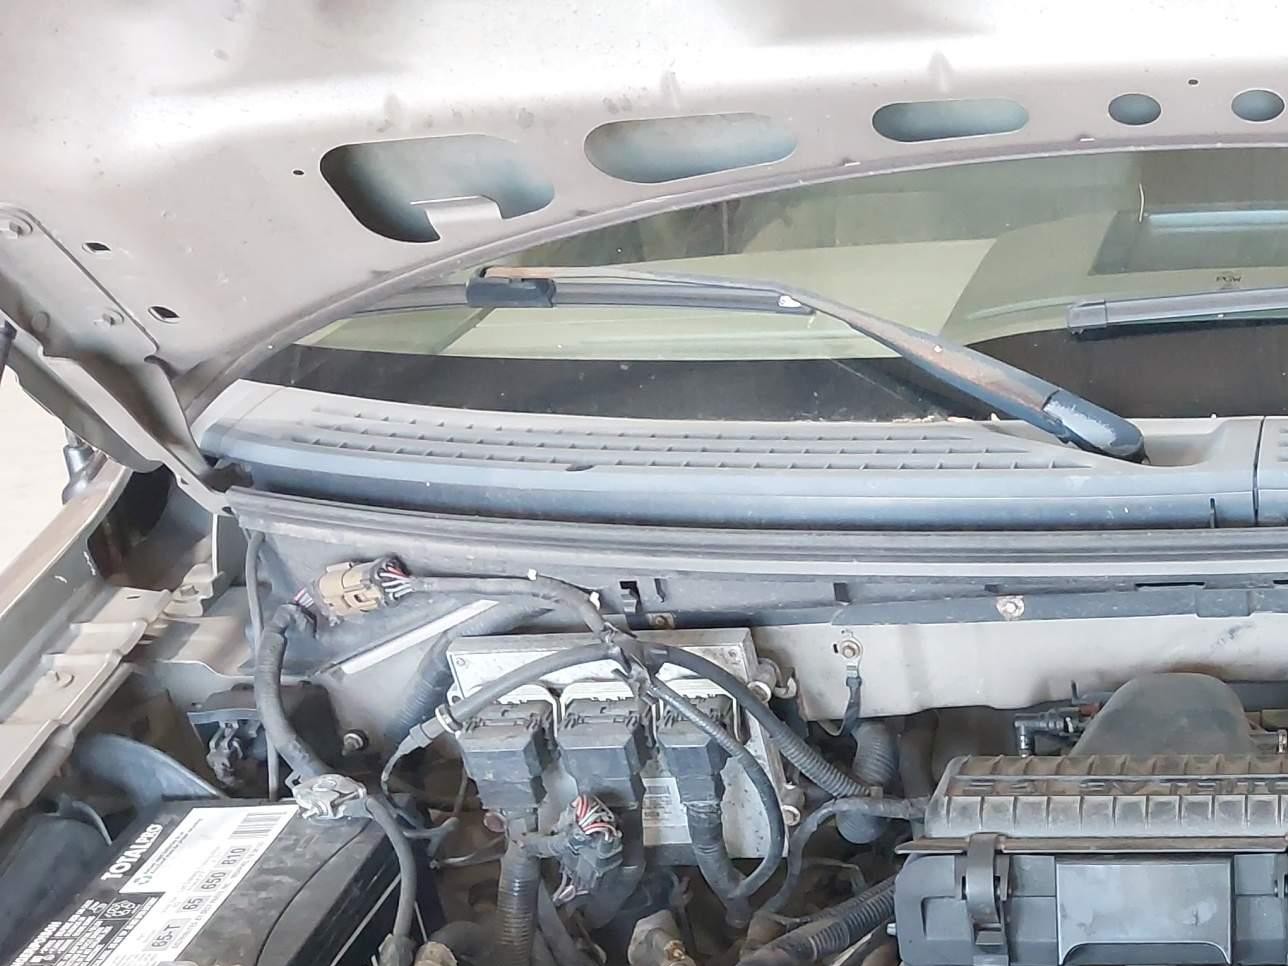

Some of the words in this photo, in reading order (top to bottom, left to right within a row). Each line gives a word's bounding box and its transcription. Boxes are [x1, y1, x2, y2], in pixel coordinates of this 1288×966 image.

[100, 823, 164, 881] TOTALPRO
[182, 897, 203, 910] 65
[200, 871, 226, 890] 650
